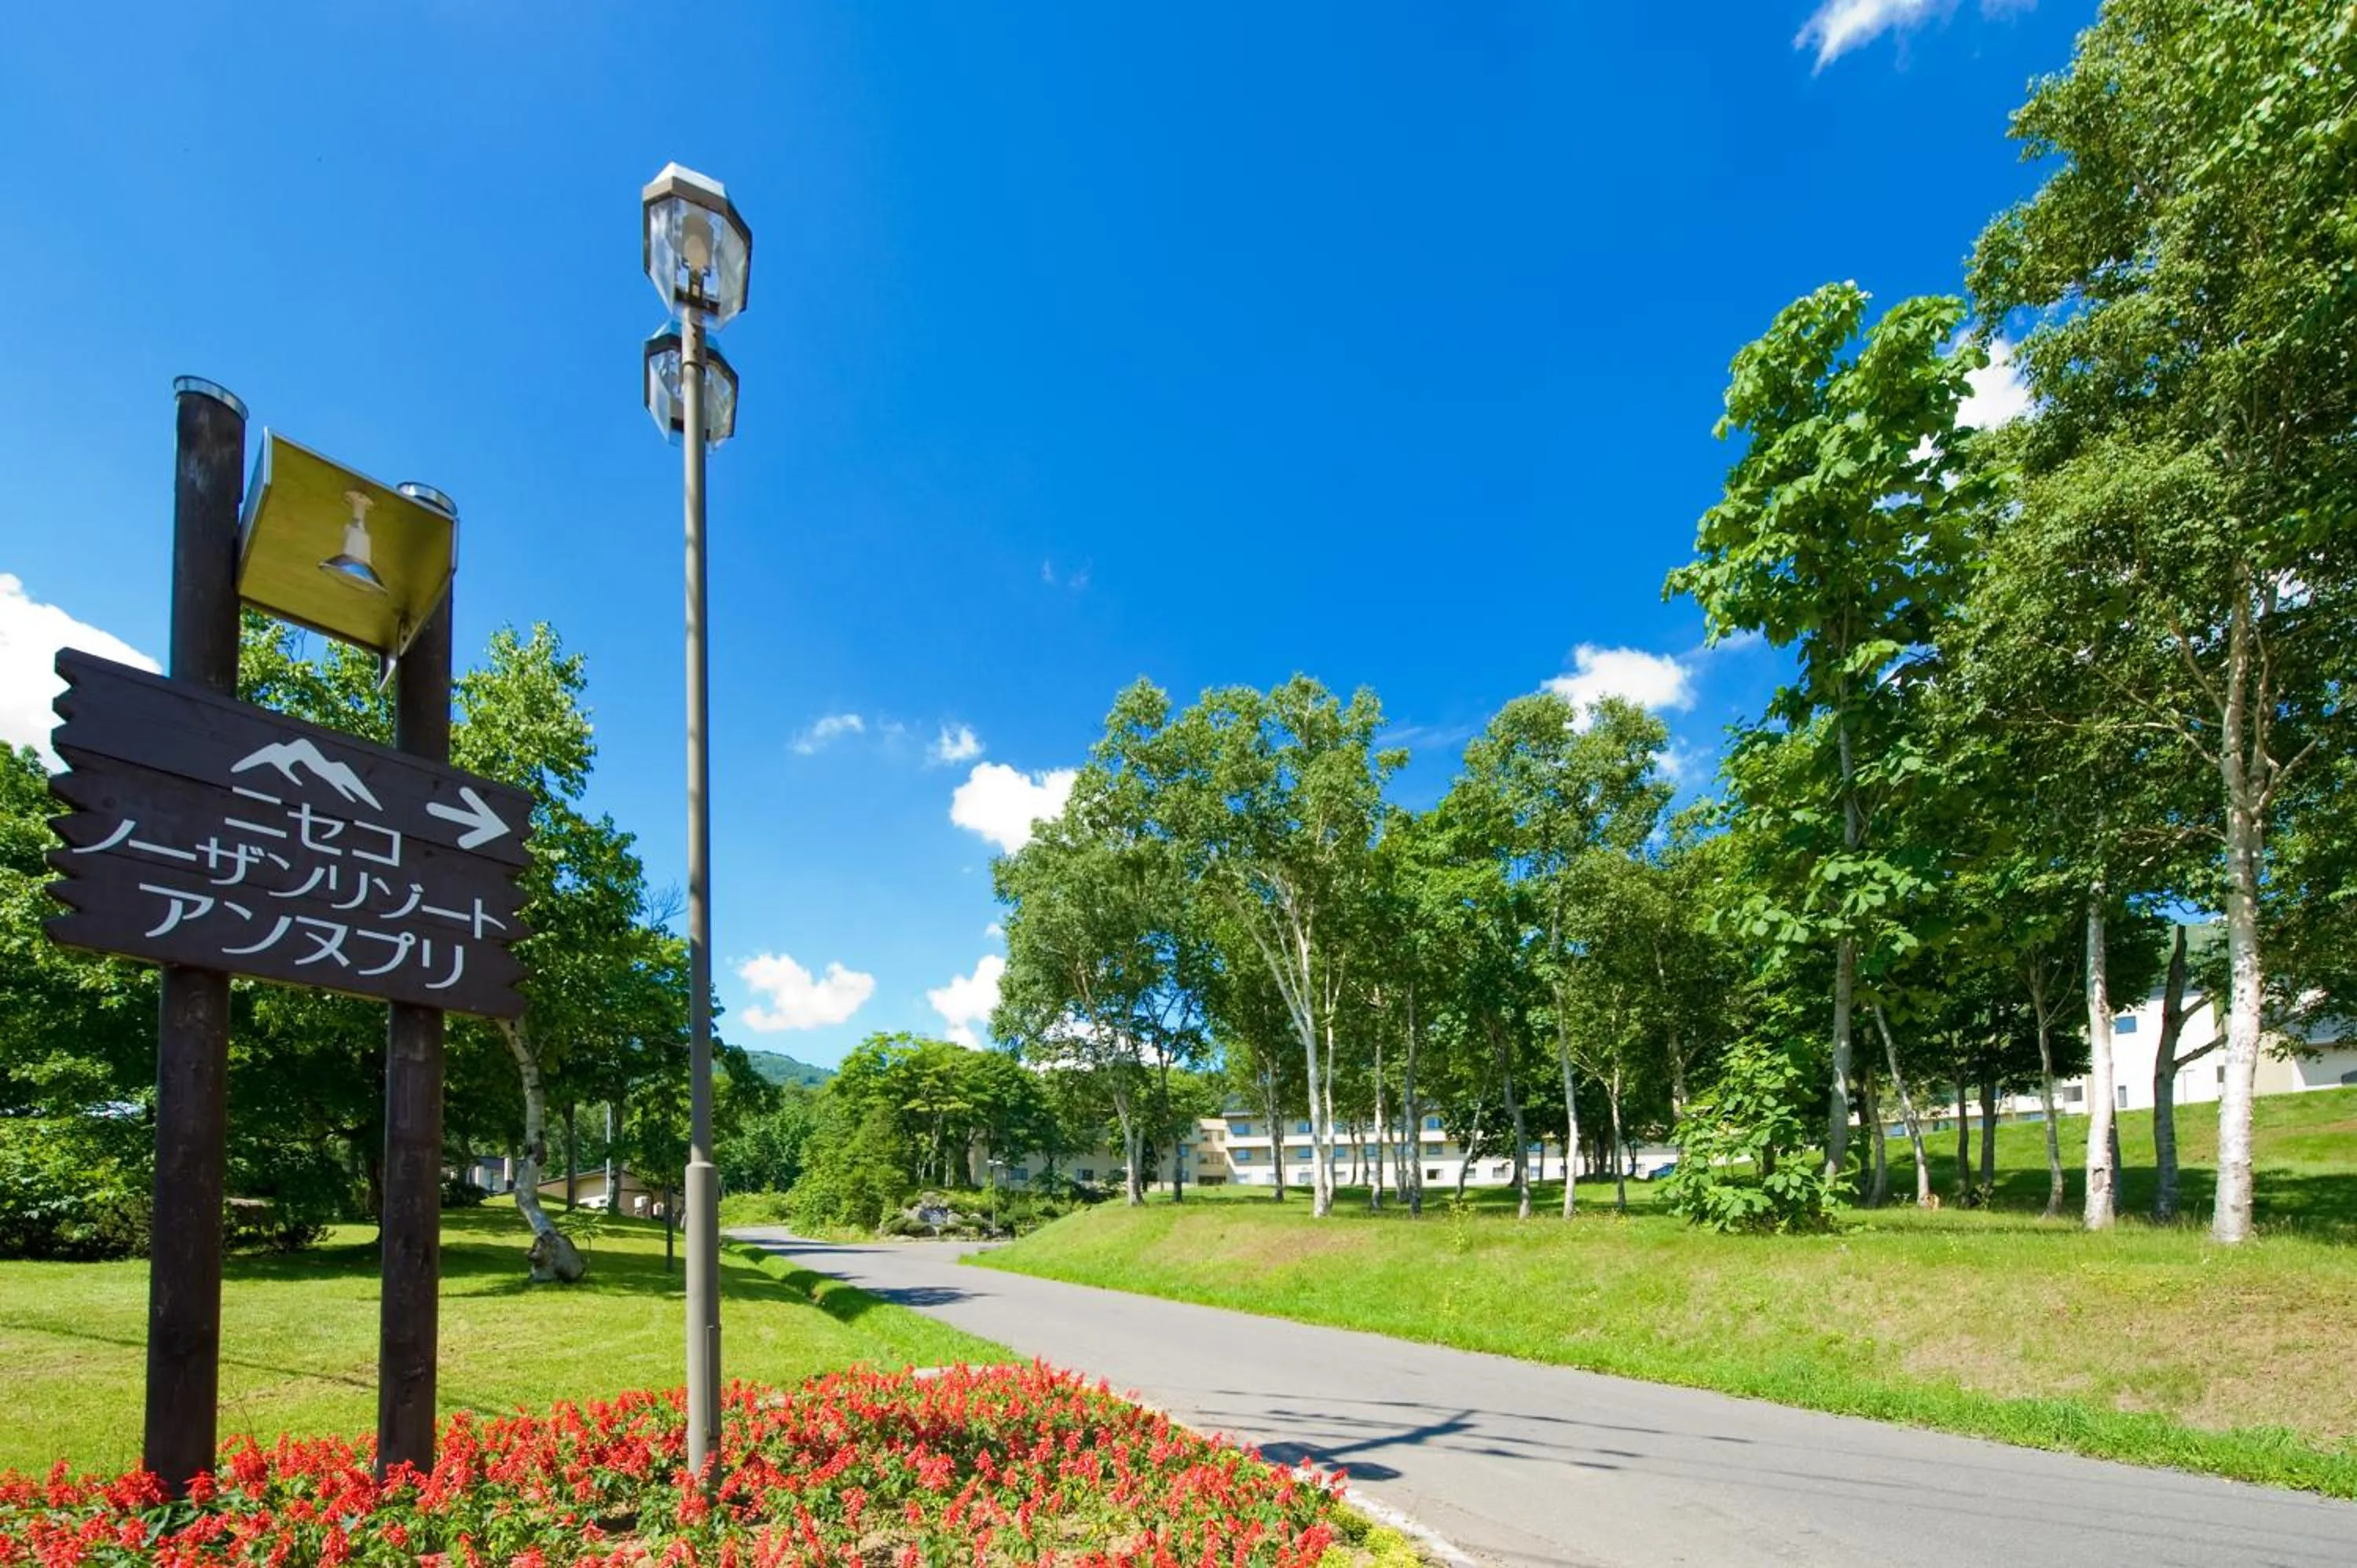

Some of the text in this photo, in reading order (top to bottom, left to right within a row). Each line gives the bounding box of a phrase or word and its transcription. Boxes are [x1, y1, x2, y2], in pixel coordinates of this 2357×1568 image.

[72, 819, 507, 940] ノーザンリゾート
[225, 786, 401, 867] ニセコ
[138, 881, 464, 989] アンヌプリ
